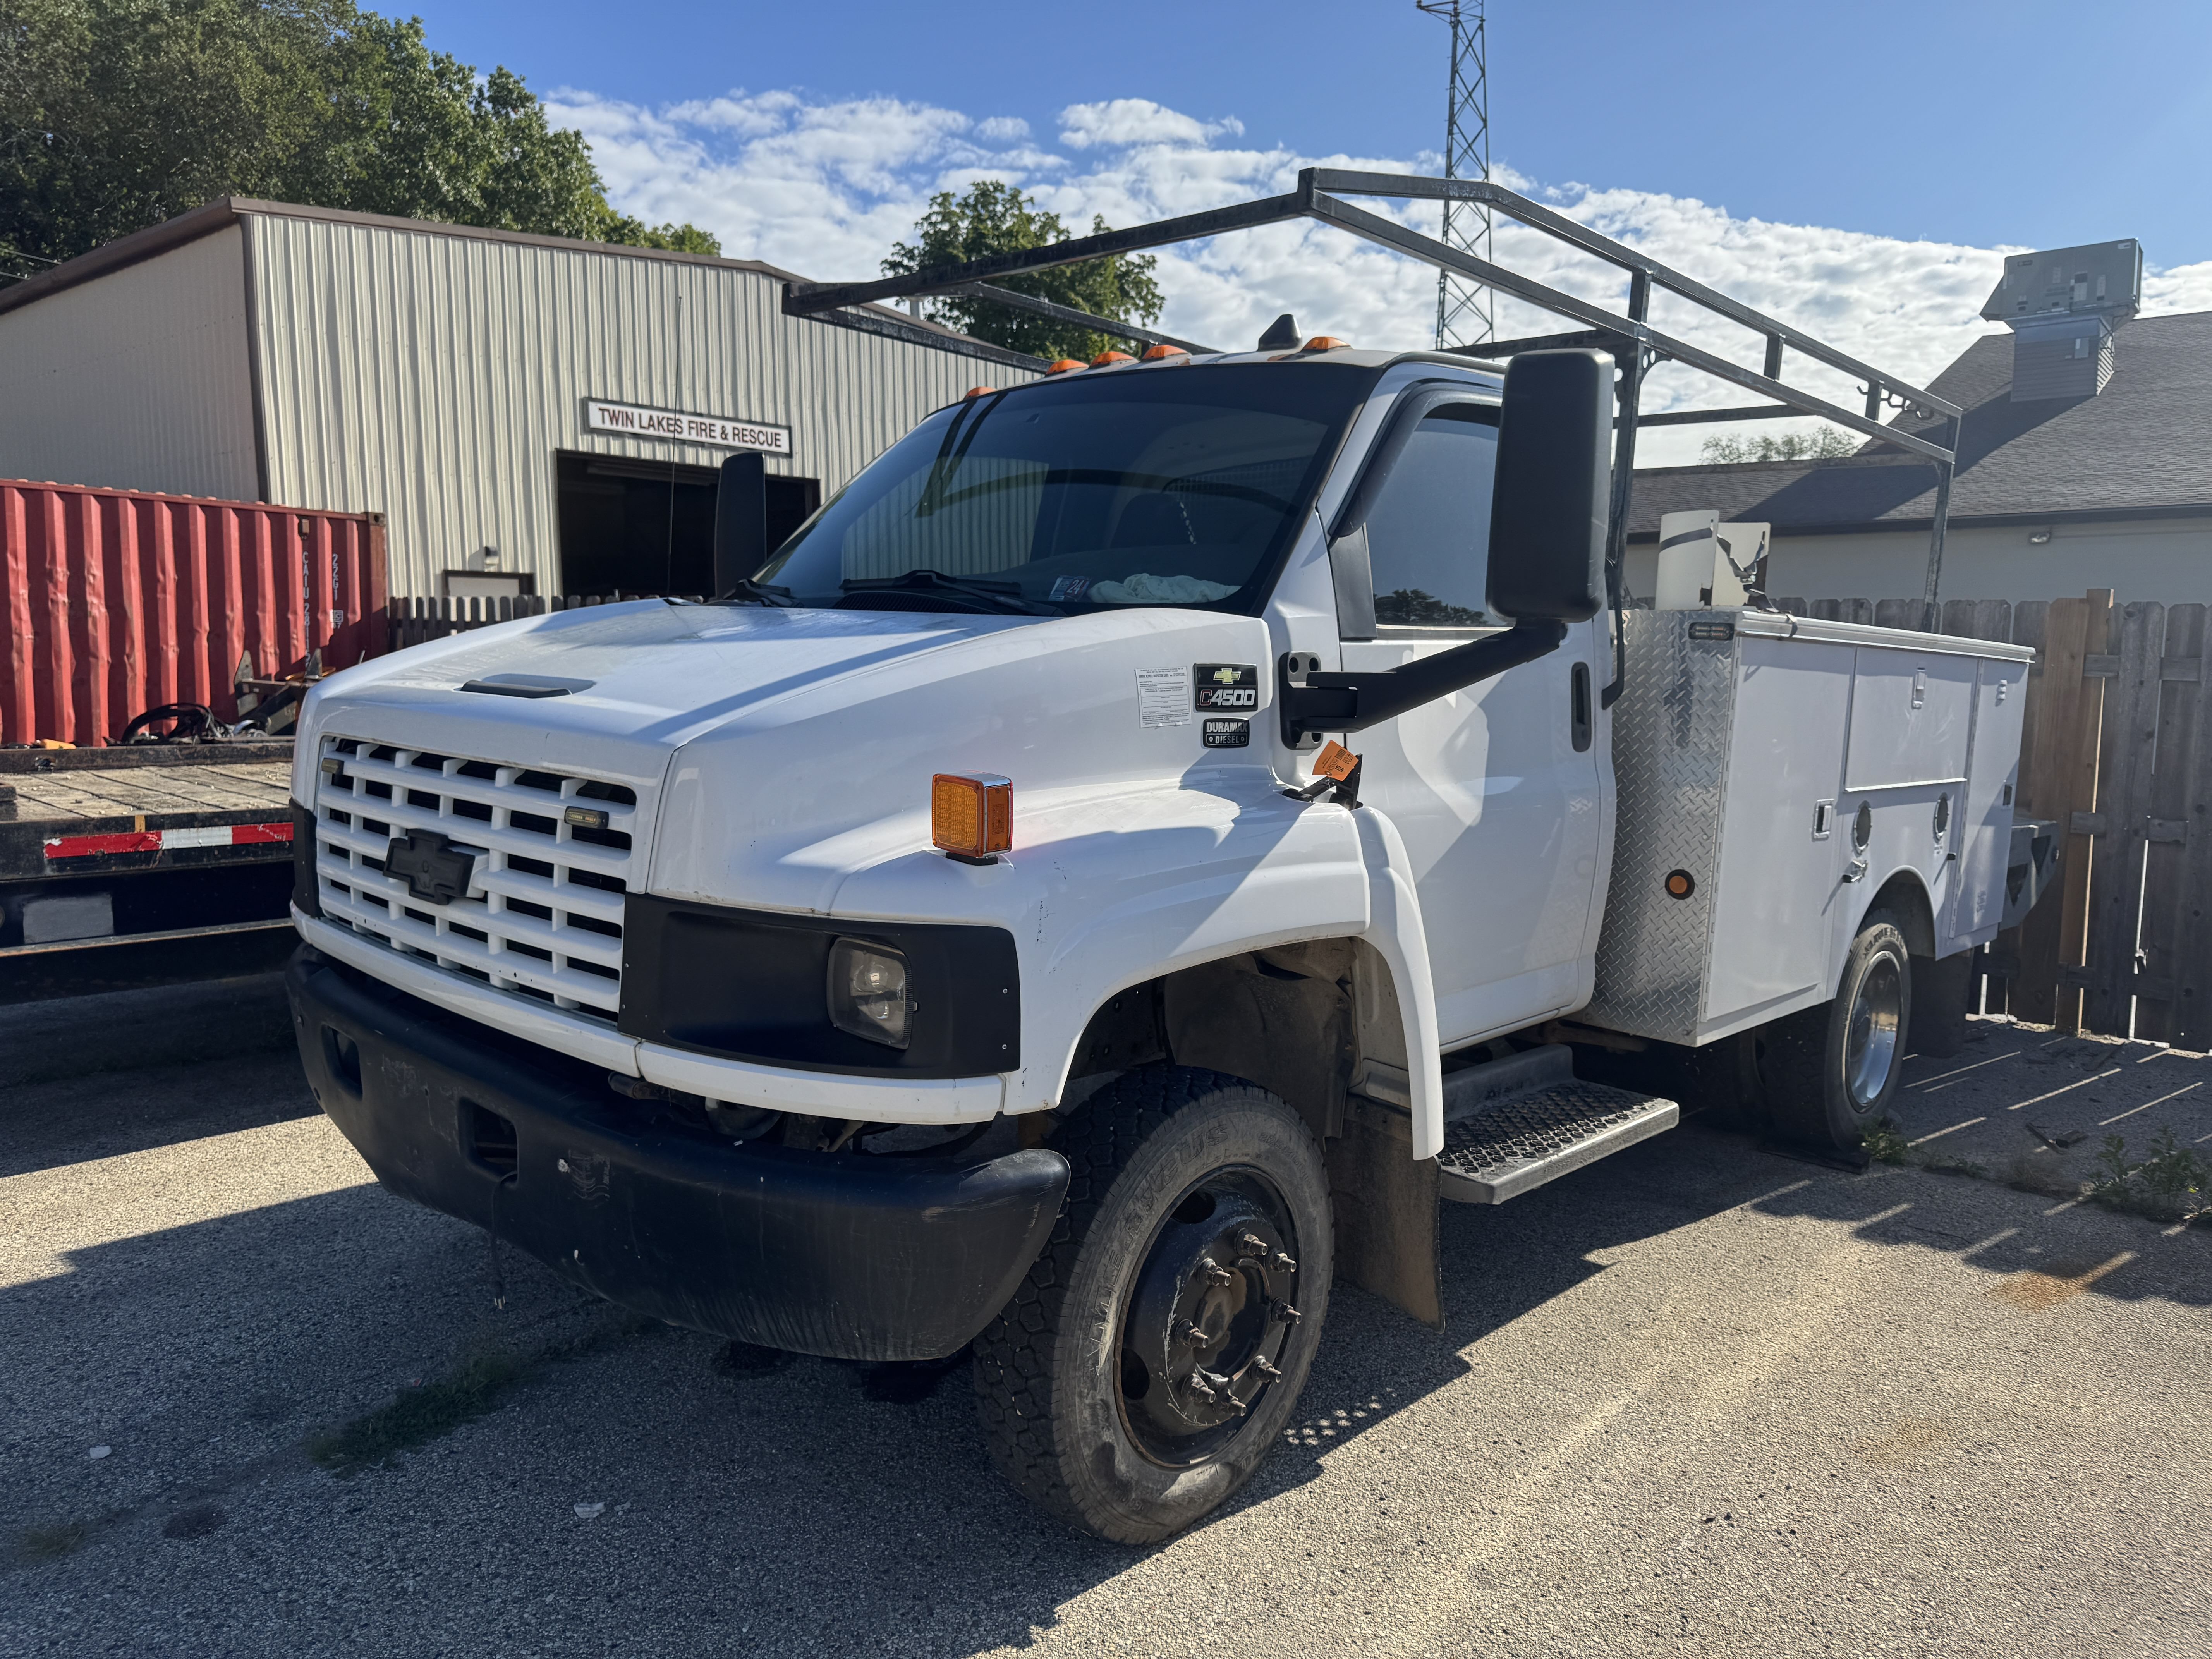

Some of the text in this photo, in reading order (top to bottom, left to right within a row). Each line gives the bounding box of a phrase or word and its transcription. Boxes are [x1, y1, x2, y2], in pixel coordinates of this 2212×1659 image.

[598, 407, 782, 447] TWIN LAKES FIRE & RESCUE
[1066, 579, 1085, 594] 24
[1200, 689, 1256, 706] C4500
[1206, 722, 1248, 733] DURAMAX
[1215, 735, 1240, 744] DIESEL
[1863, 927, 1905, 960] AMERIC
